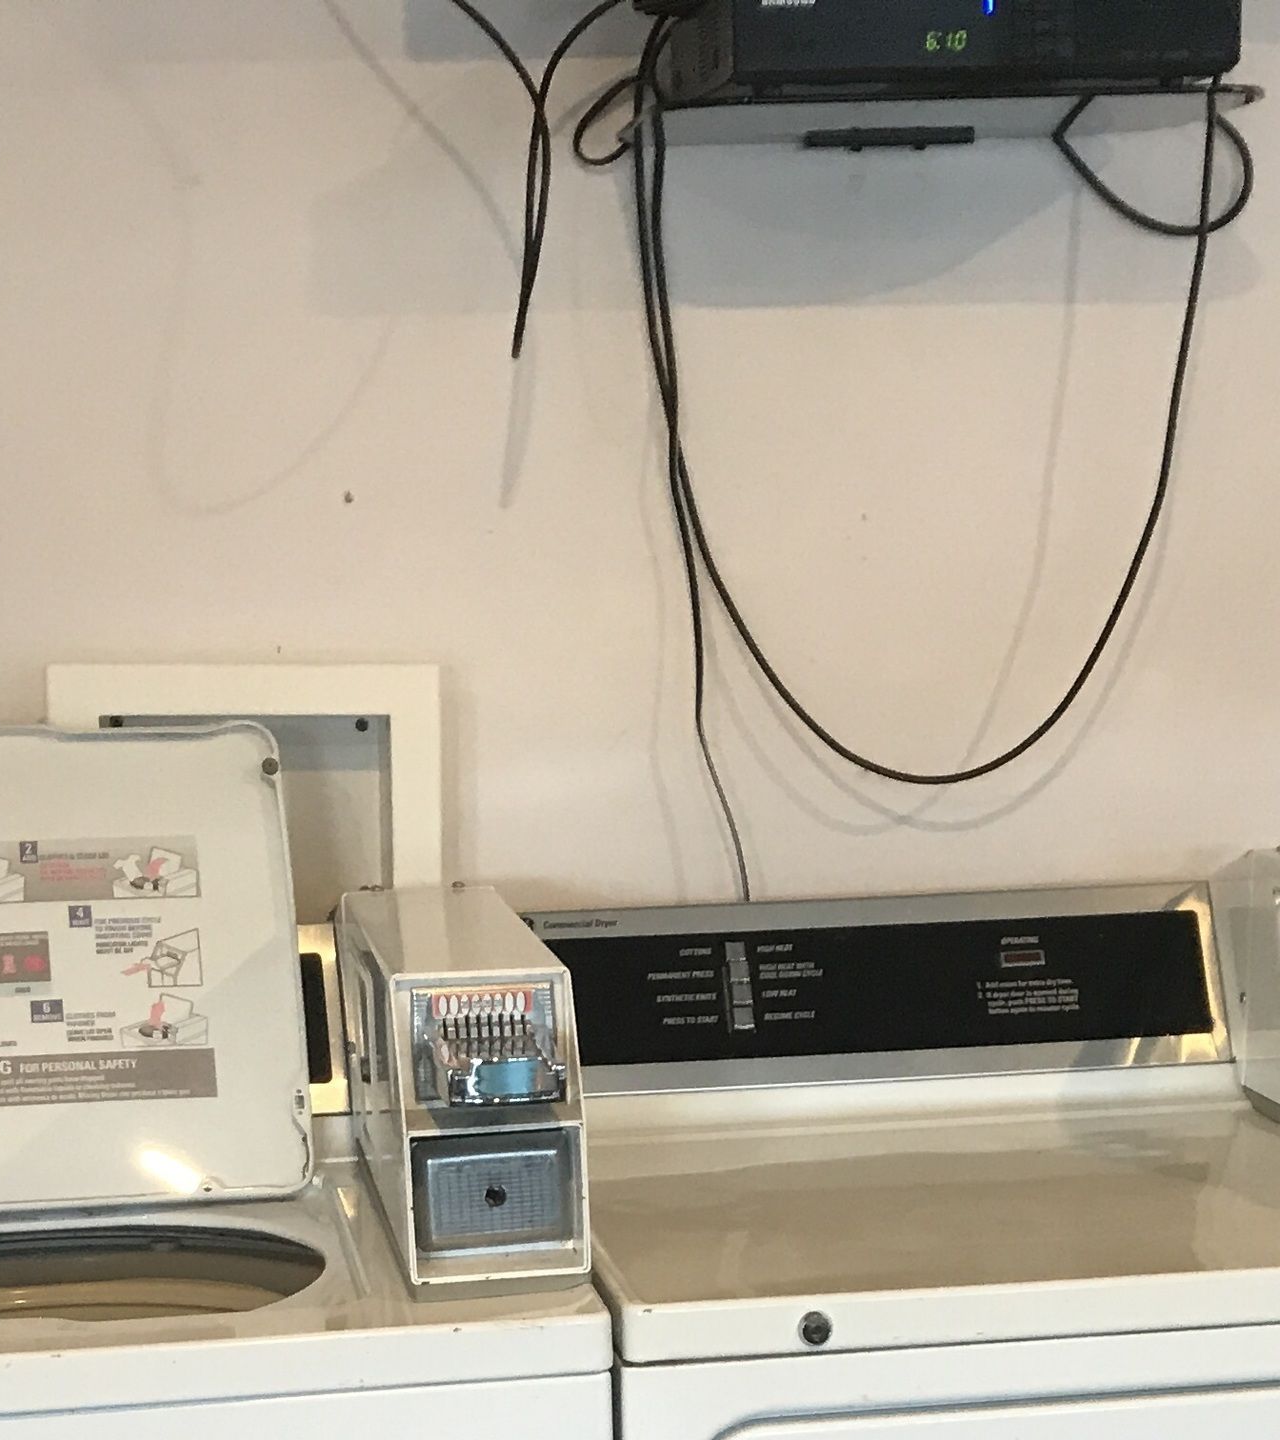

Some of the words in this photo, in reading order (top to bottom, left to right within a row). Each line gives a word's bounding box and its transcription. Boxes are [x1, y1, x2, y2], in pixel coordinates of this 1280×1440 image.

[24, 843, 33, 855] 2
[76, 907, 84, 918] 4
[543, 918, 594, 930] Commercial
[595, 918, 620, 929] Dryer
[42, 1002, 51, 1013] 6
[19, 1063, 40, 1074] FOR
[42, 1061, 97, 1073] PERSONAL
[99, 1059, 138, 1071] SAFETY
